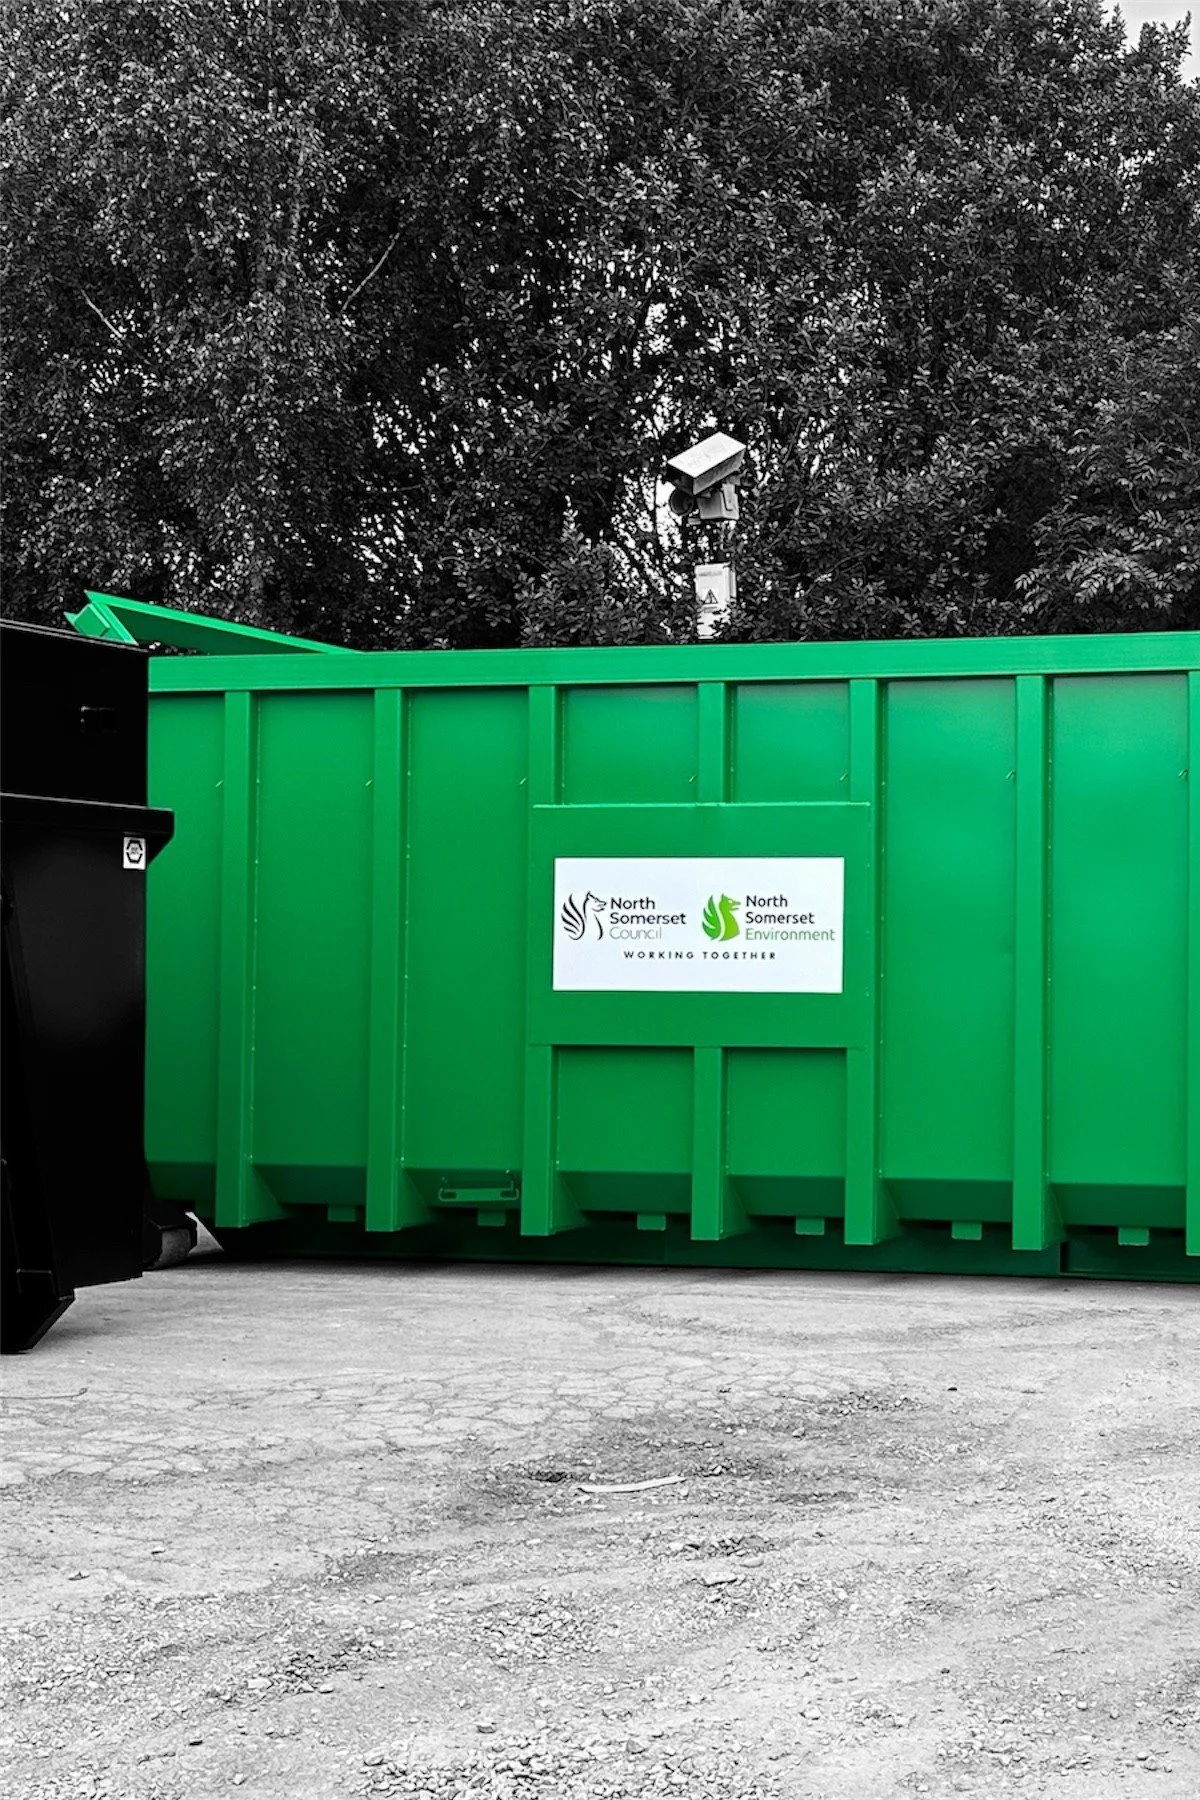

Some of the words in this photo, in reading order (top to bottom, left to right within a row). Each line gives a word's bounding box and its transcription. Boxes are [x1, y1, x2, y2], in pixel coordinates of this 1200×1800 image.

[610, 896, 656, 910] North
[745, 894, 789, 908] North
[609, 911, 687, 925] Somerset
[745, 911, 816, 925] Somerset
[609, 927, 663, 940] Council
[745, 927, 836, 941] Environment
[623, 950, 695, 960] WORKING
[702, 950, 776, 960] TOGETHER
